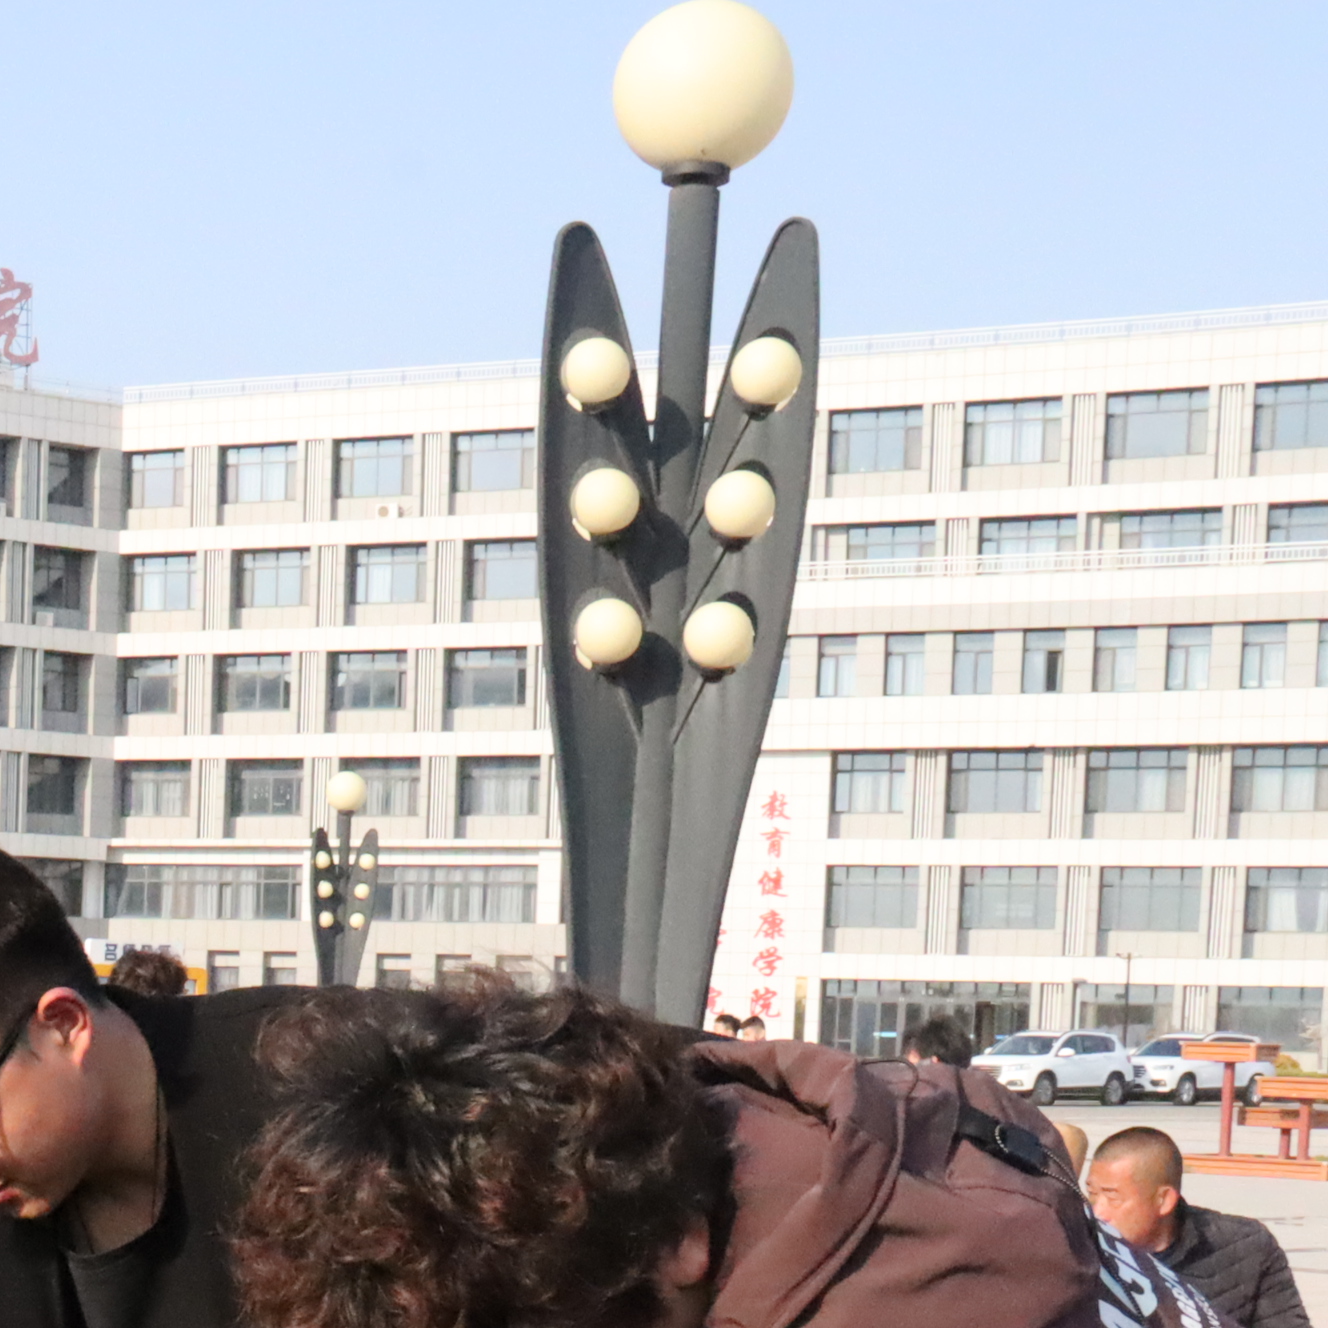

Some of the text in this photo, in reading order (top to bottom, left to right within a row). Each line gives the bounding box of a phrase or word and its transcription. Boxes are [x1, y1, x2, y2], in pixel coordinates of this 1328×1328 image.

[749, 790, 791, 1018] 教育健康学院
